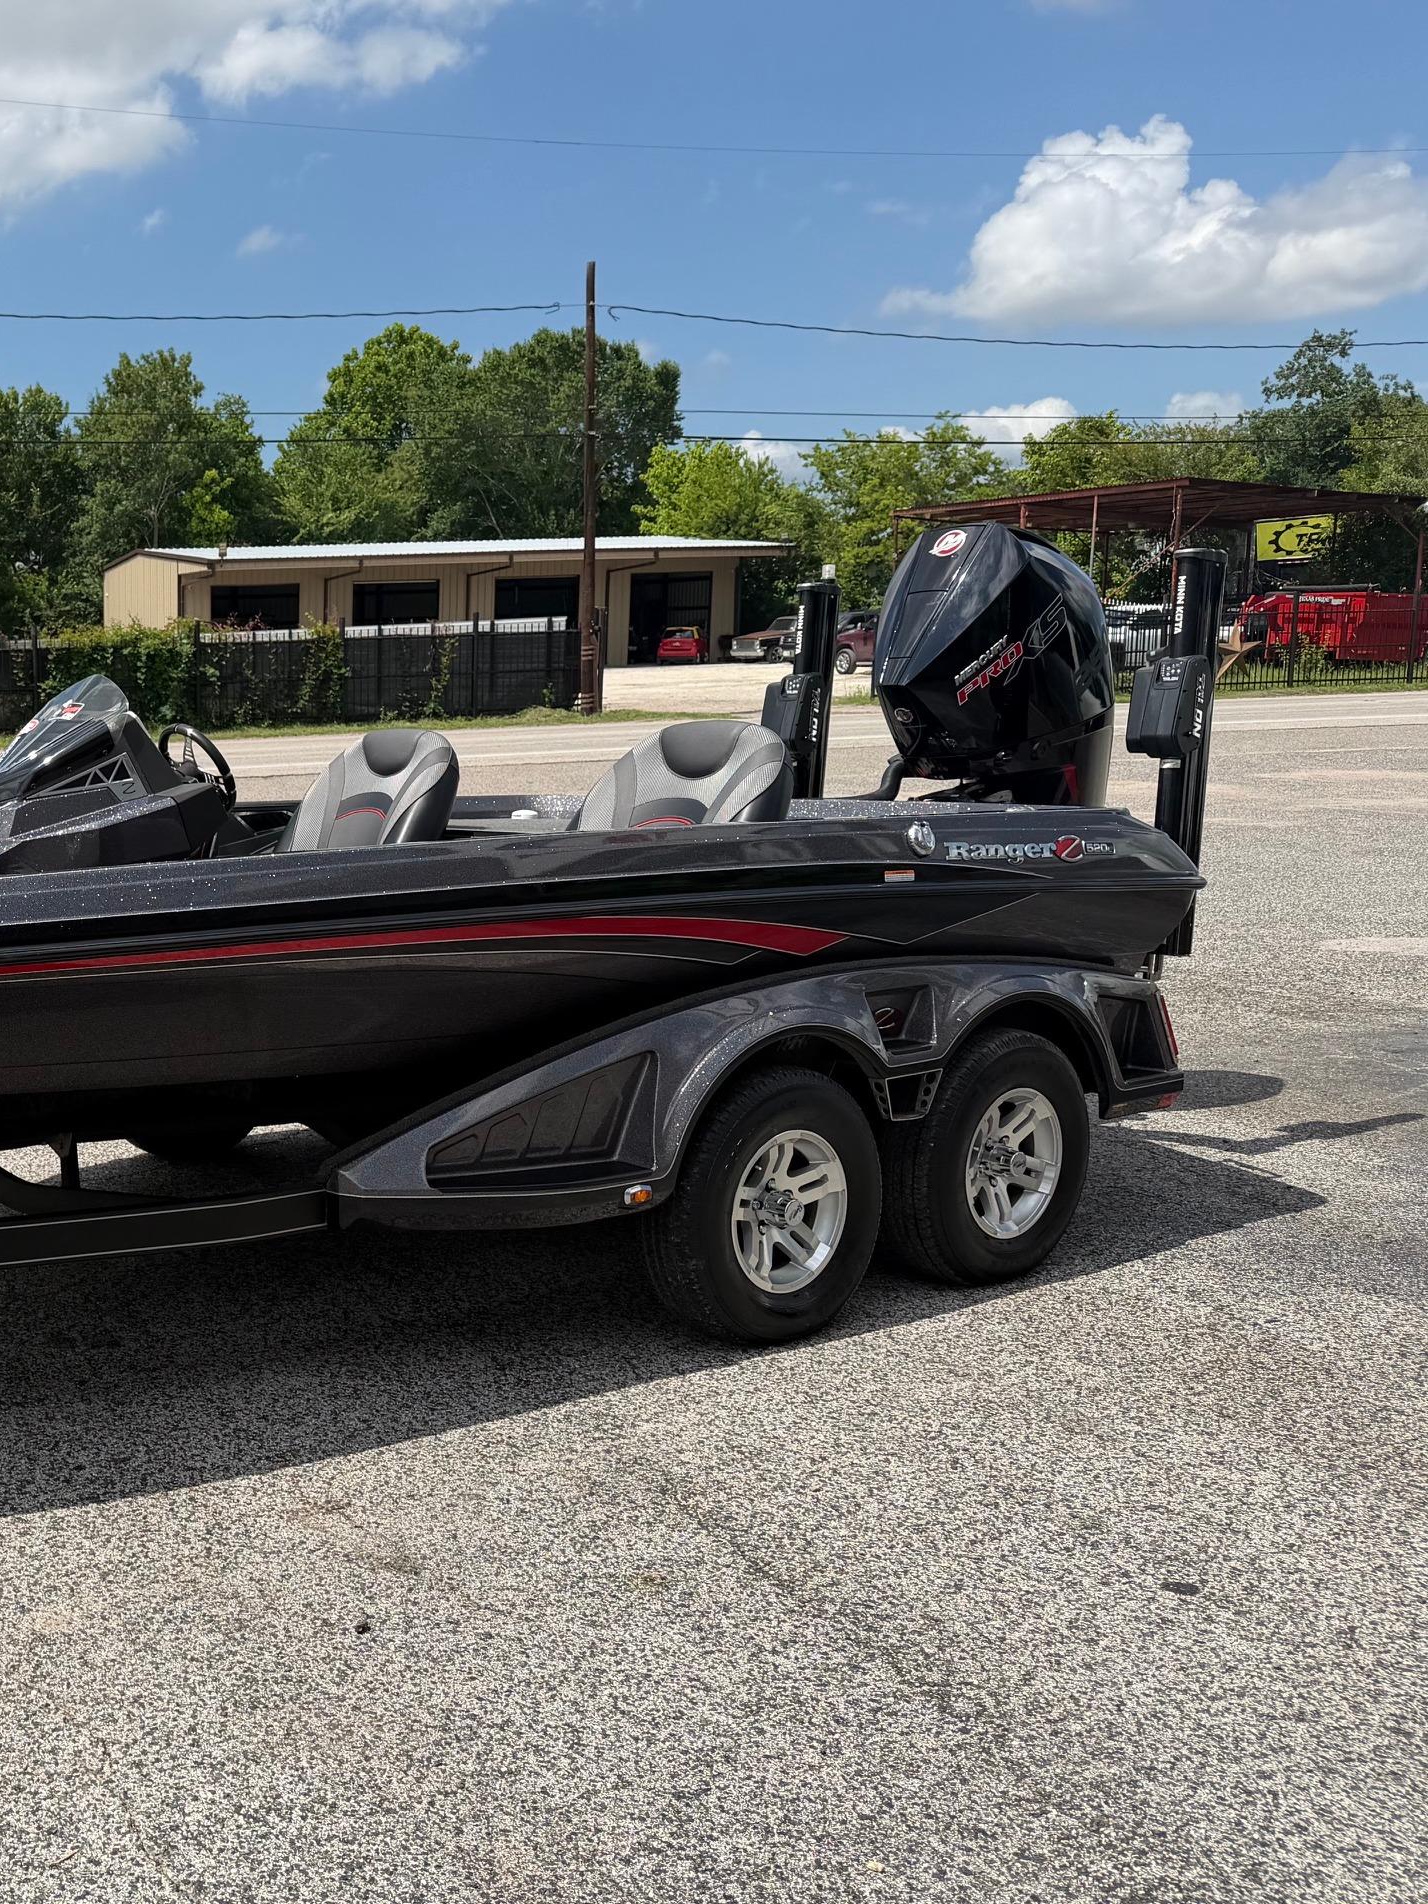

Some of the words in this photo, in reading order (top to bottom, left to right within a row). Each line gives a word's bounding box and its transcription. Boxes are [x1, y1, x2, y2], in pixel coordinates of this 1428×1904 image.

[1175, 575, 1186, 606] MINN
[797, 605, 806, 631] MINN
[1173, 606, 1184, 635] KOTA
[795, 631, 804, 655] KOTA
[953, 634, 1008, 687] MERCURY
[1191, 673, 1206, 739] TALON
[943, 840, 1058, 865] Ranger
